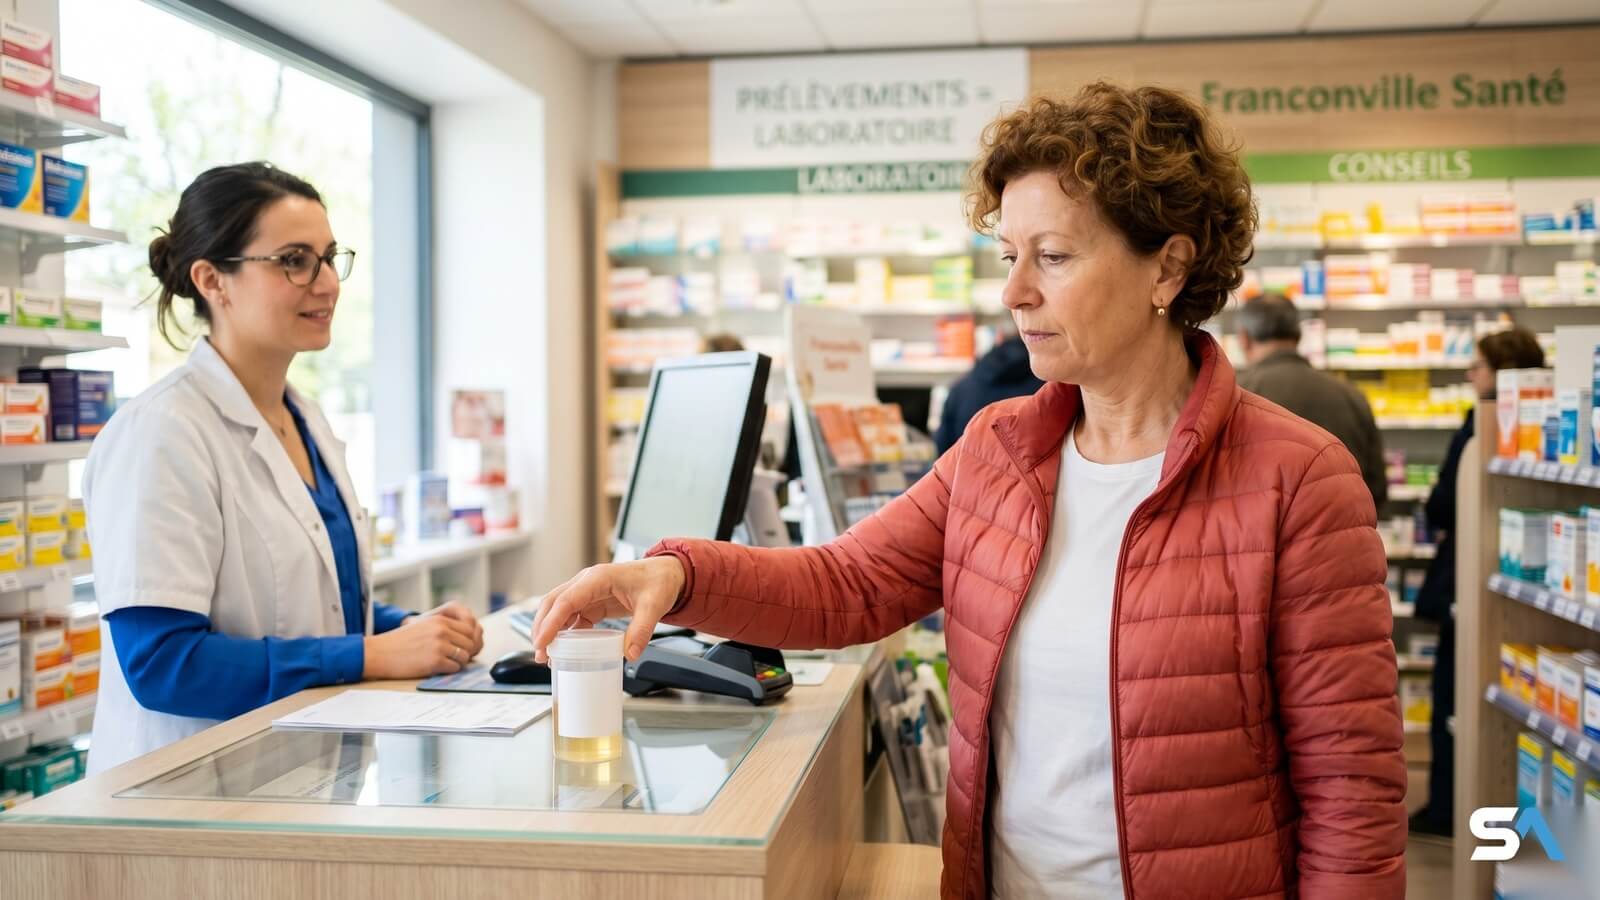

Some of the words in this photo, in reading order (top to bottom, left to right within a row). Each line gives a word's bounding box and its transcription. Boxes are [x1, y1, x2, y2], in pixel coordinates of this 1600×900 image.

[736, 78, 966, 113] PRÉLÈVEMENTS
[1202, 74, 1440, 113] Franconville
[1452, 68, 1566, 107] Santé
[754, 117, 956, 148] LABORATOIRE
[798, 160, 966, 193] LABORATOIR
[1328, 151, 1472, 181] CONSEILS
